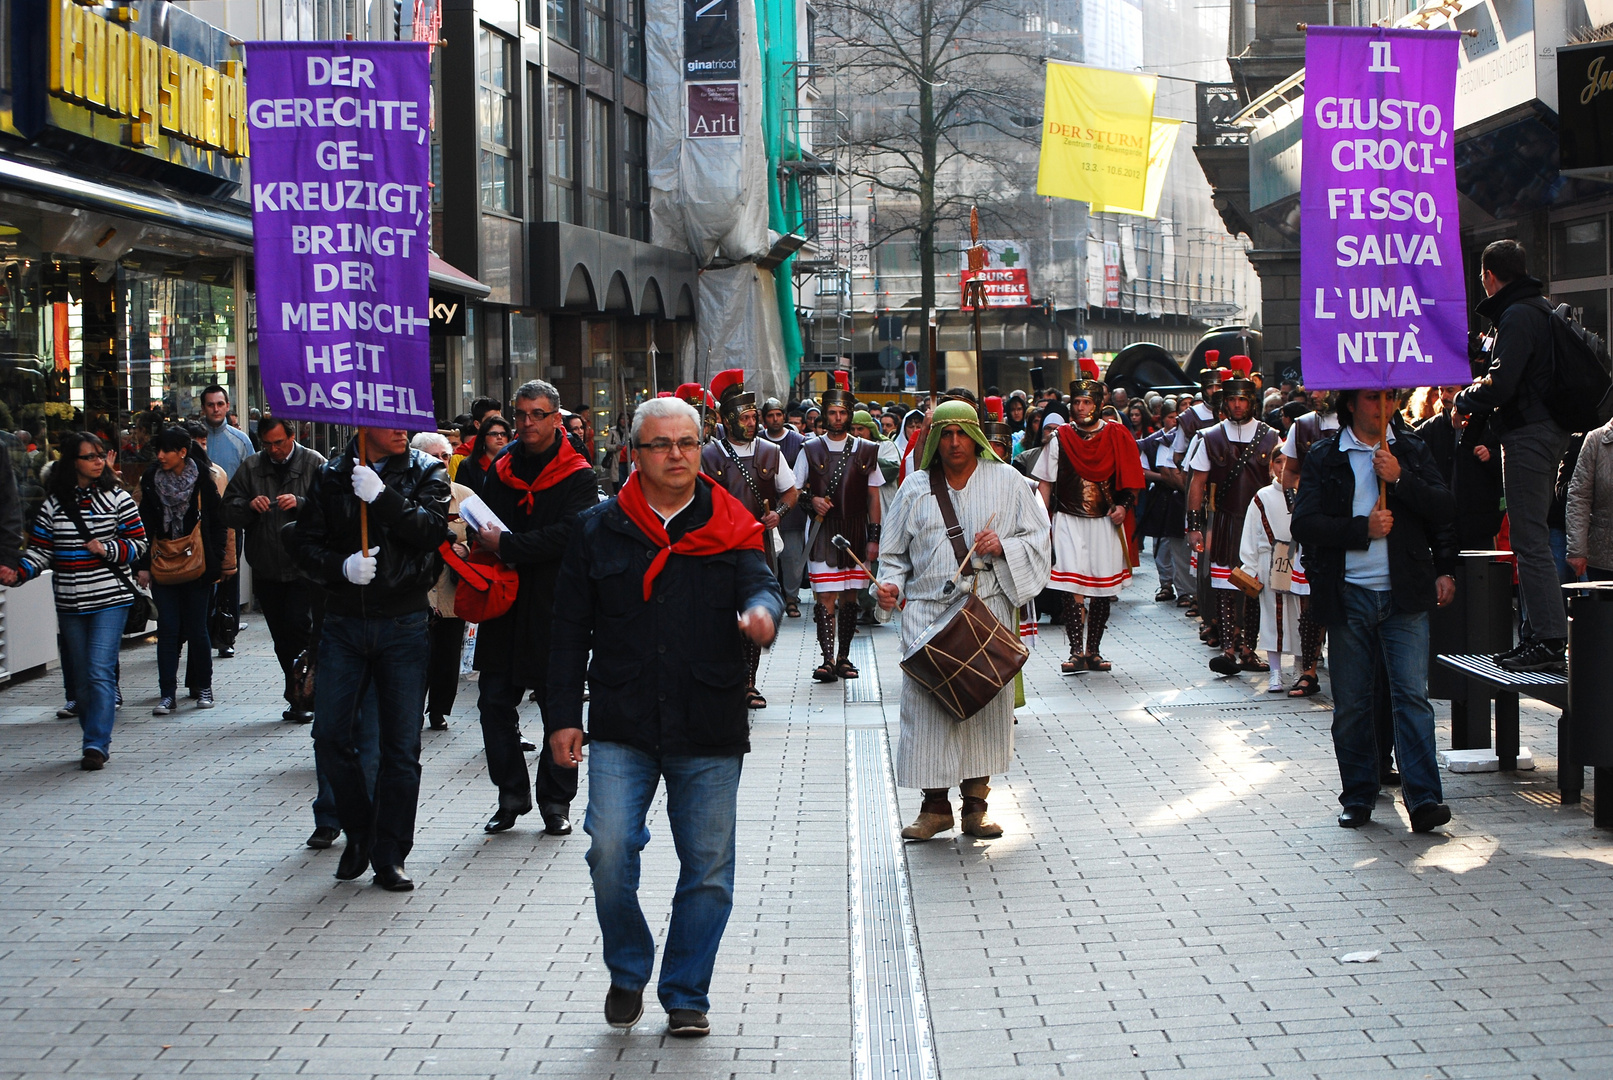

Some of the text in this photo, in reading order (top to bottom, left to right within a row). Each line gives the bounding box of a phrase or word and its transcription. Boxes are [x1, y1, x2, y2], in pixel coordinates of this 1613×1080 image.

[307, 55, 375, 89] DER
[1368, 41, 1400, 73] IL
[249, 96, 426, 145] GERECHTE,
[692, 113, 736, 134] Arlt
[1049, 122, 1144, 149] DER STURM
[1315, 97, 1448, 149] GIUSTO,
[316, 140, 374, 171] GE-
[1063, 138, 1143, 158] Zentrum der Avantgarde
[1331, 138, 1447, 174] CROCI-
[1081, 162, 1099, 172] 13.3.
[1107, 165, 1141, 179] 10.6.2012
[253, 180, 424, 226] KREUZIGT,
[1327, 187, 1443, 234] FISSO,
[291, 223, 417, 258] BRINGT
[1336, 233, 1442, 267] SALVA
[313, 261, 377, 292] DER
[978, 272, 1014, 281] BURG
[281, 301, 430, 335] MENSCH-
[305, 341, 385, 373] HEIT
[1337, 323, 1433, 364] NITÀ.
